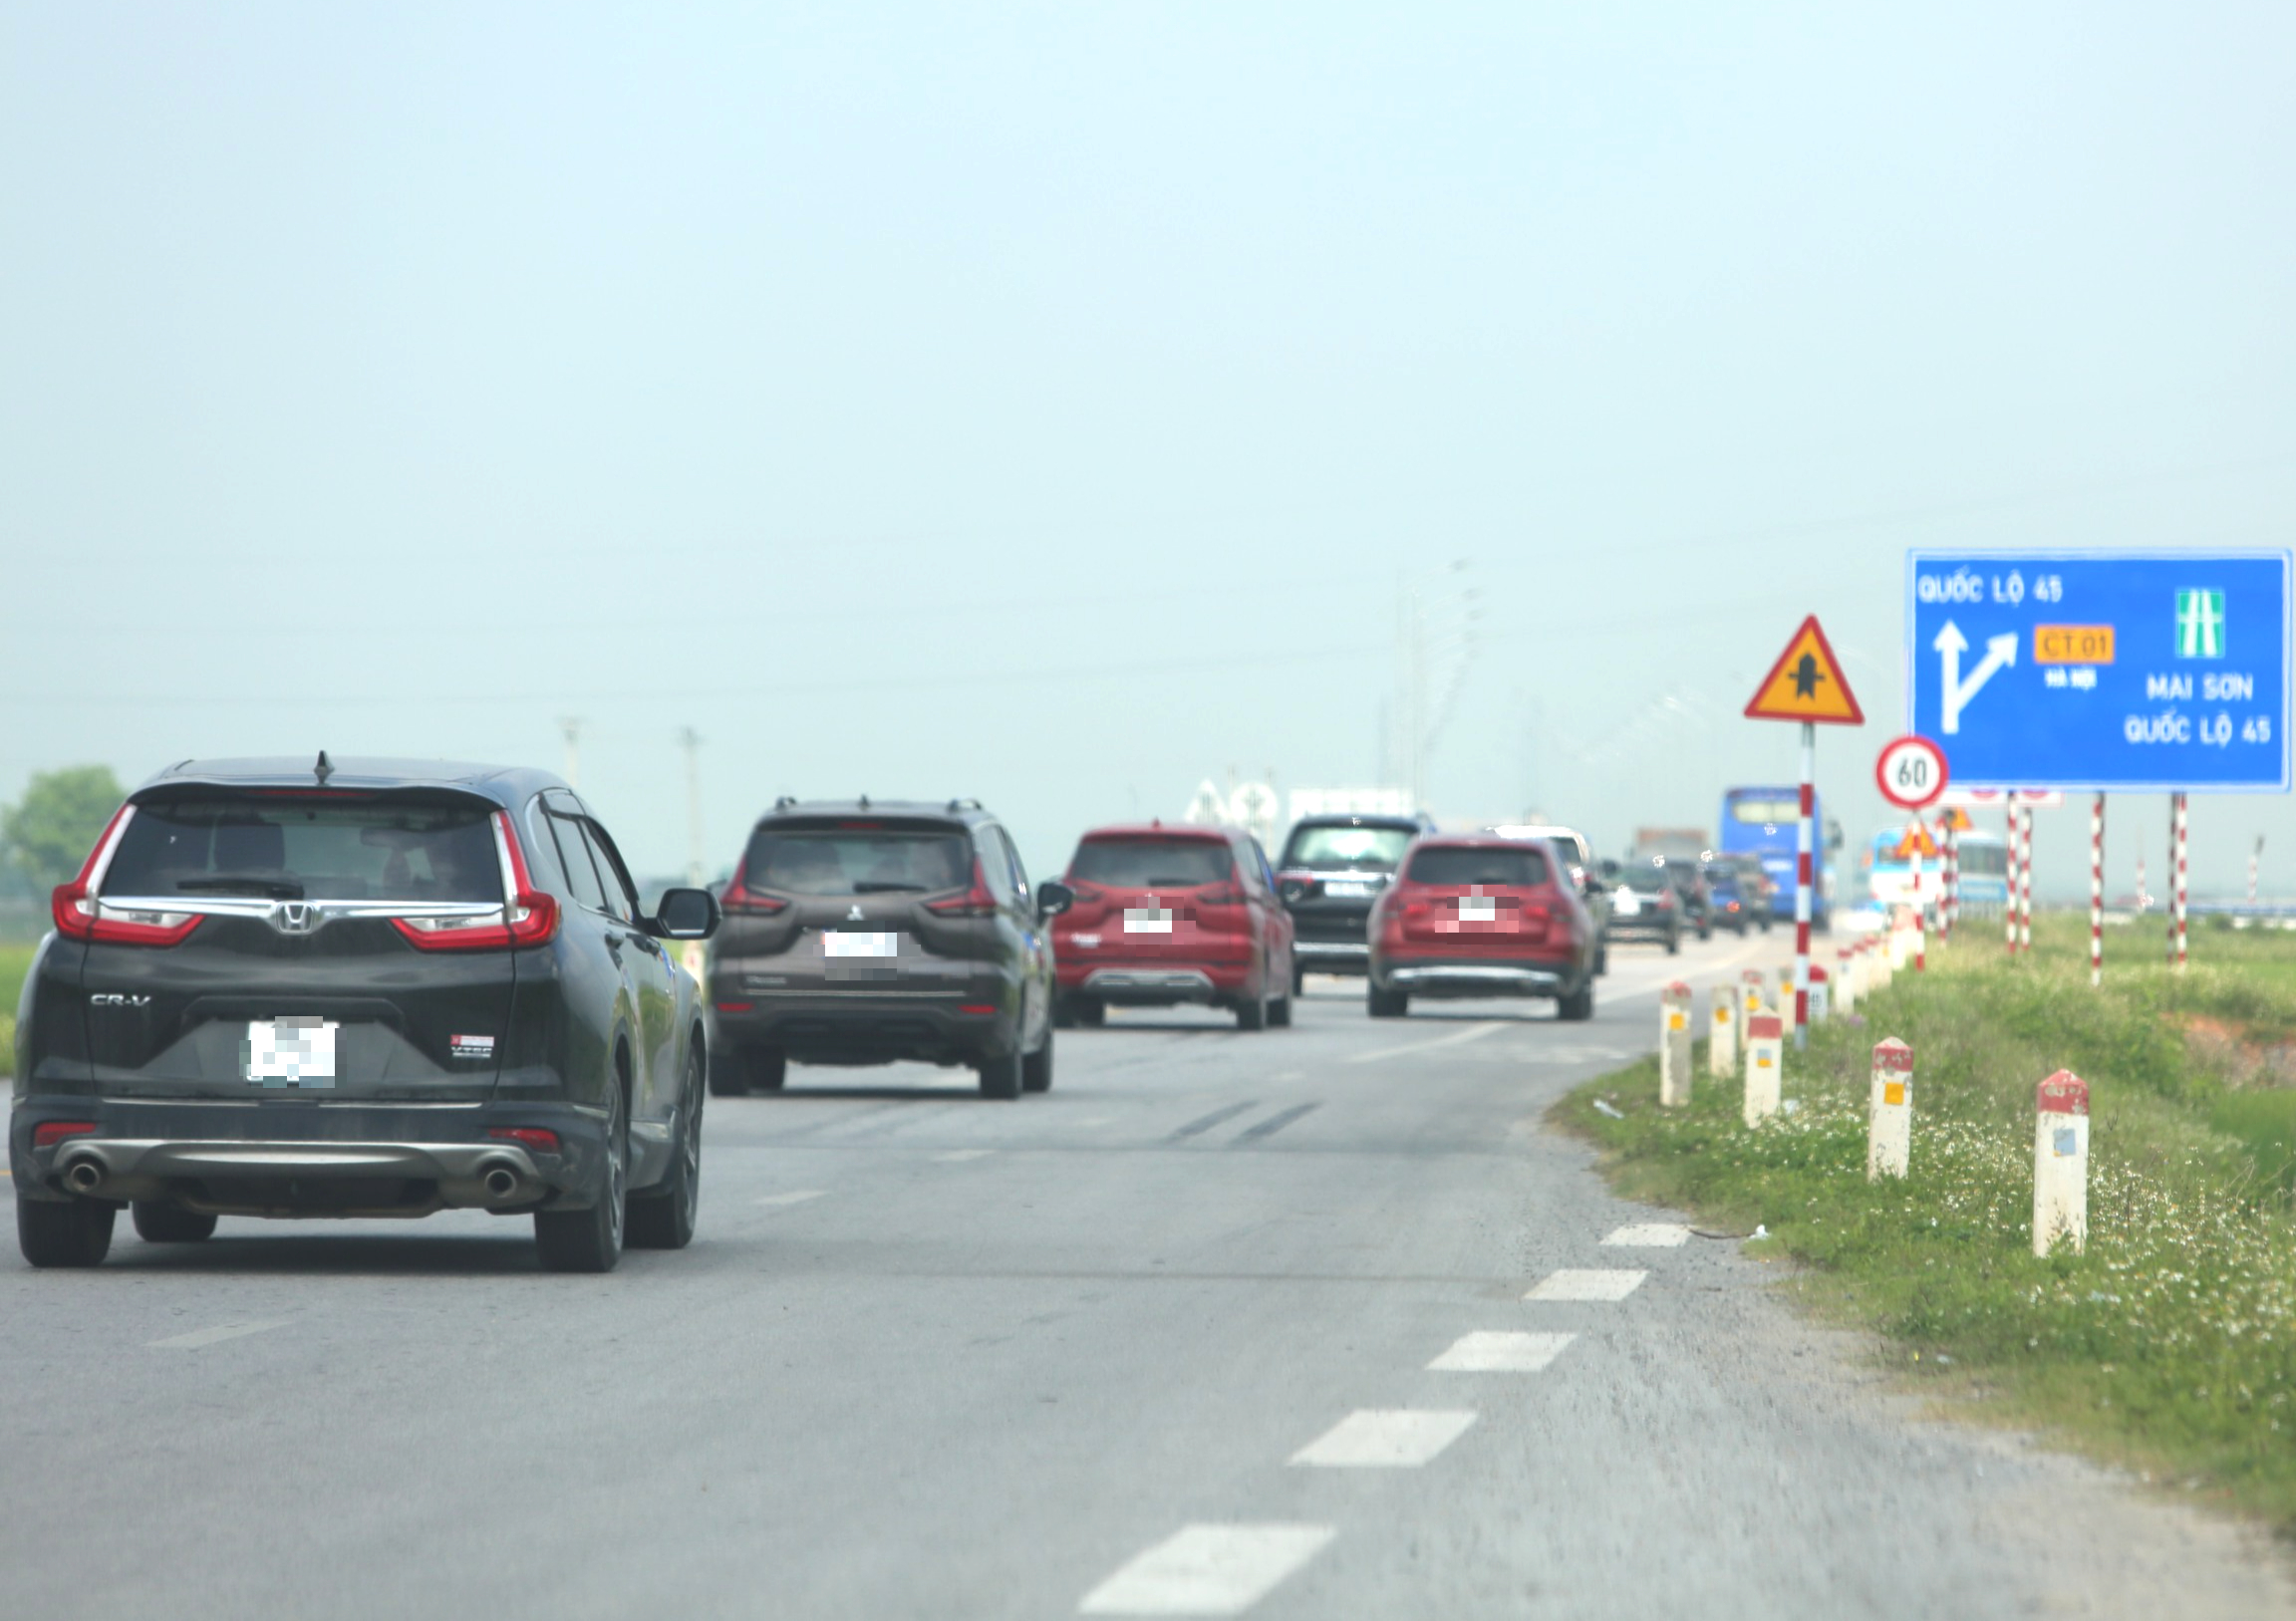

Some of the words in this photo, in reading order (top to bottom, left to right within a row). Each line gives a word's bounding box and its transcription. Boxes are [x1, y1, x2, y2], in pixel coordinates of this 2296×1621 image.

[1917, 565, 1984, 604] QUỐC
[1991, 568, 2025, 608] LỘ
[2033, 574, 2063, 604] 45
[2147, 672, 2192, 700] MAI
[2202, 672, 2254, 700] SƠN
[2124, 705, 2191, 744] QUỐC
[2199, 708, 2233, 748] LỘ
[2242, 714, 2272, 744] 45
[1898, 757, 1927, 787] 60
[91, 993, 151, 1006] CR-V
